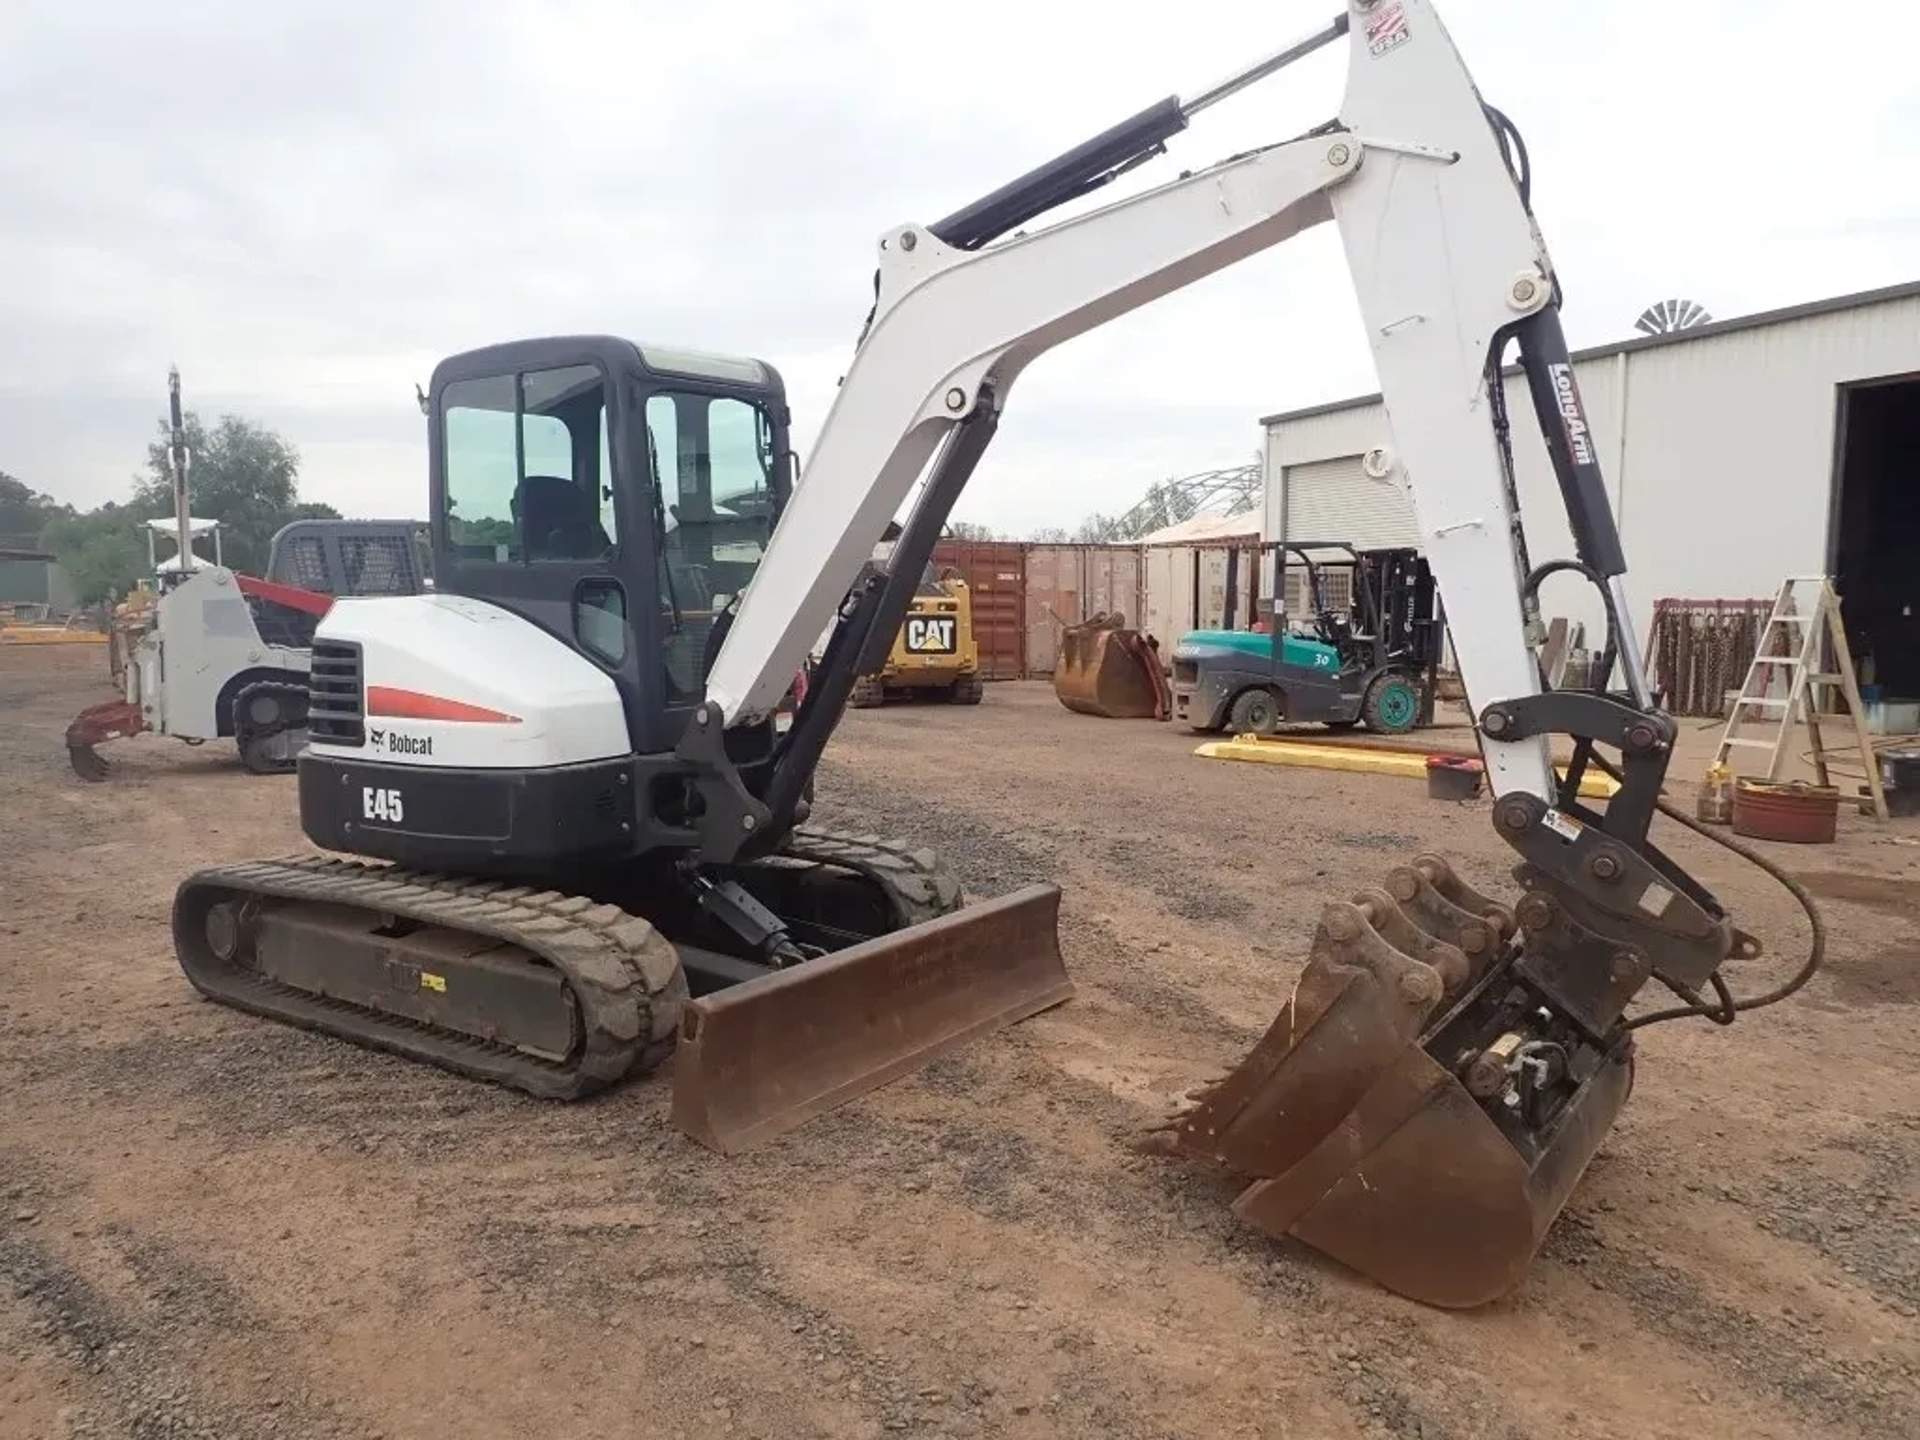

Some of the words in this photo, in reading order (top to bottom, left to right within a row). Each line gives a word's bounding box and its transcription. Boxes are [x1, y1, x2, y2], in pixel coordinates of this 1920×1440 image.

[908, 619, 954, 650] CAT
[1314, 653, 1329, 665] 30
[389, 732, 433, 756] Bobcat
[363, 787, 404, 822] E45
